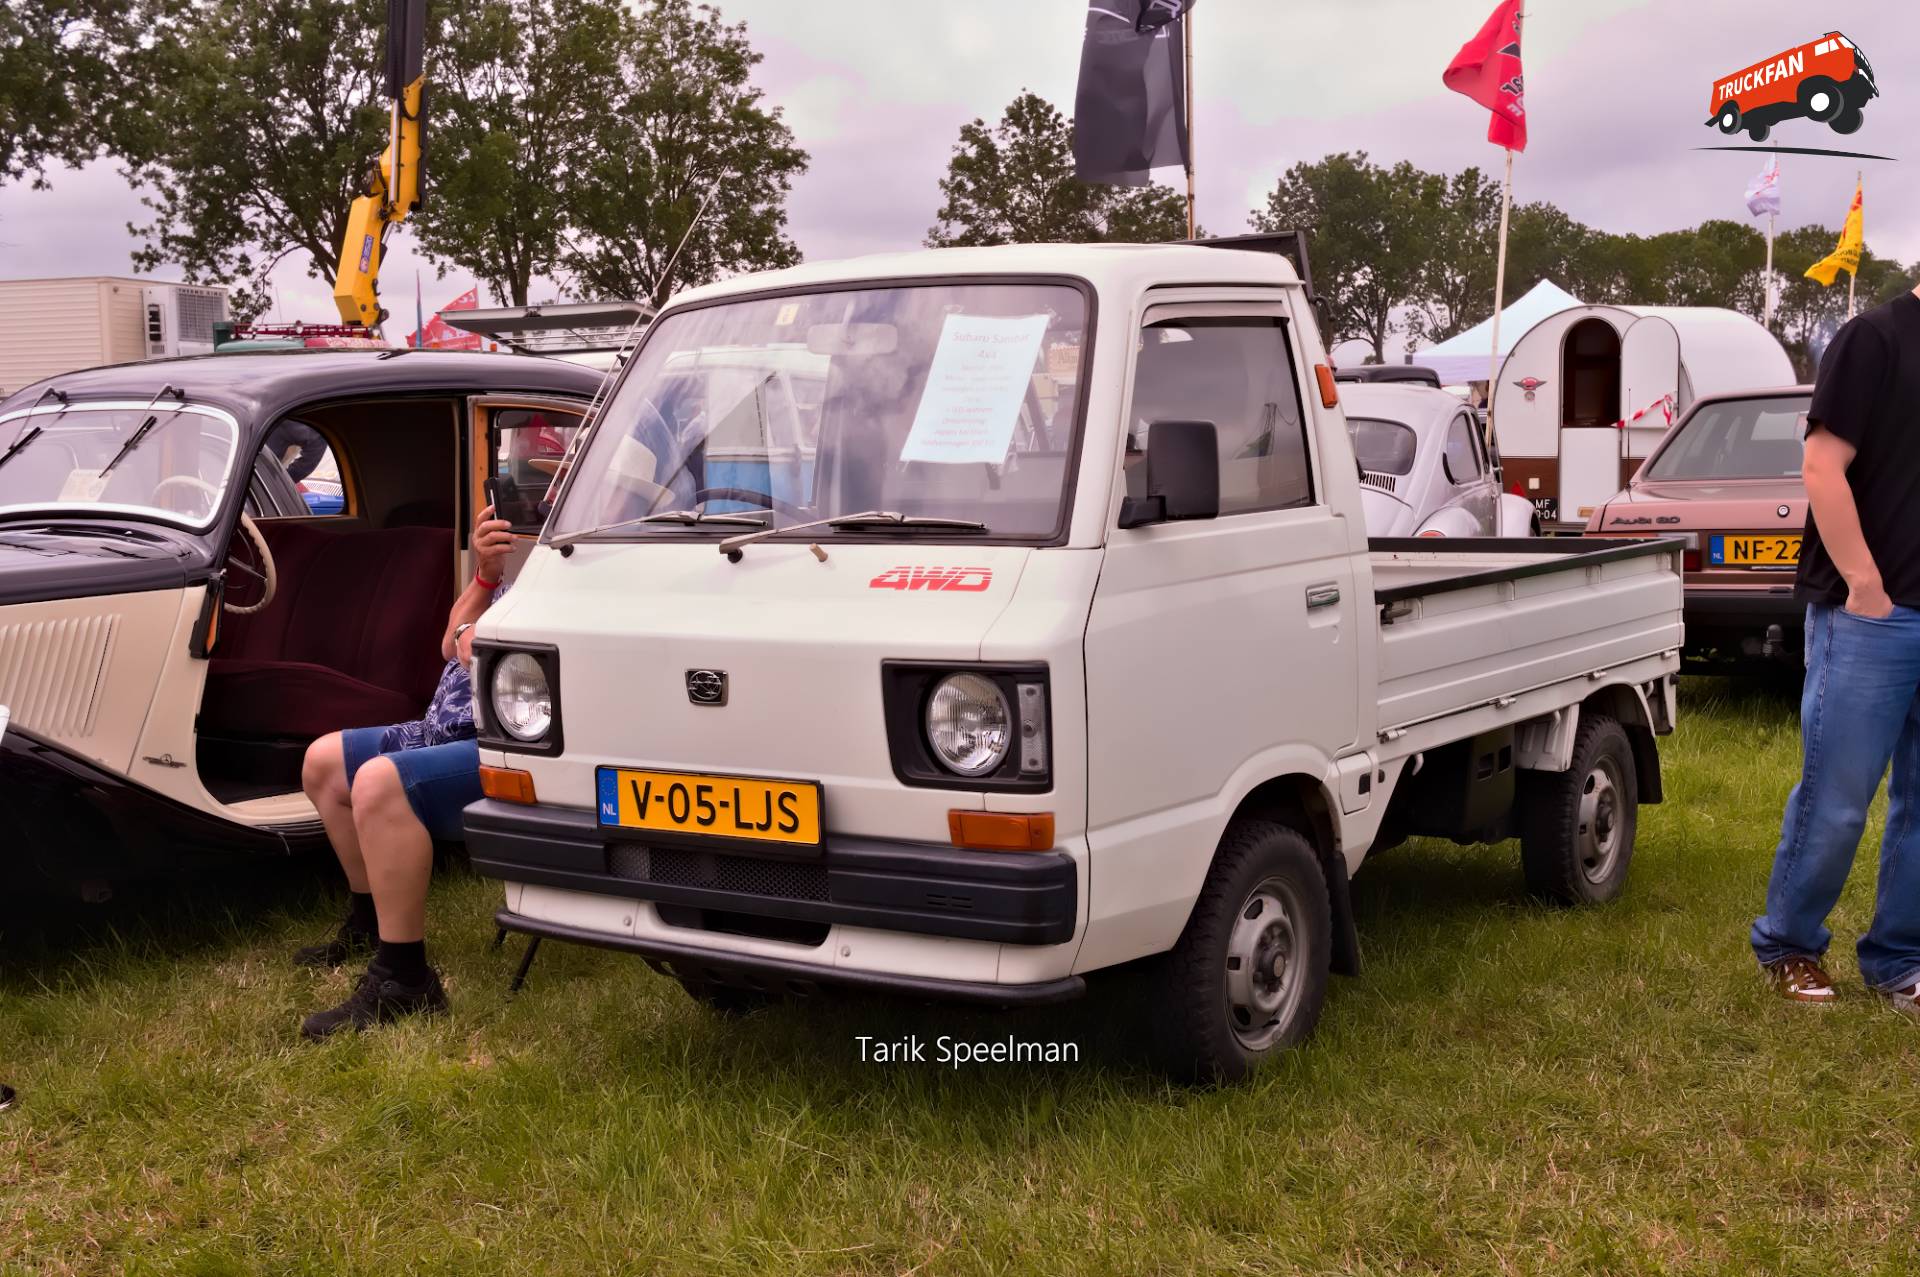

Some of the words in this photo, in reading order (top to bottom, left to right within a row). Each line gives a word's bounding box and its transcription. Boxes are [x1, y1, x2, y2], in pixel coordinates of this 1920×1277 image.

[1535, 499, 1551, 509] MF
[1712, 552, 1723, 560] NL
[869, 565, 993, 592] 4WD
[602, 802, 617, 816] NL
[630, 779, 800, 833] V-05-LJS
